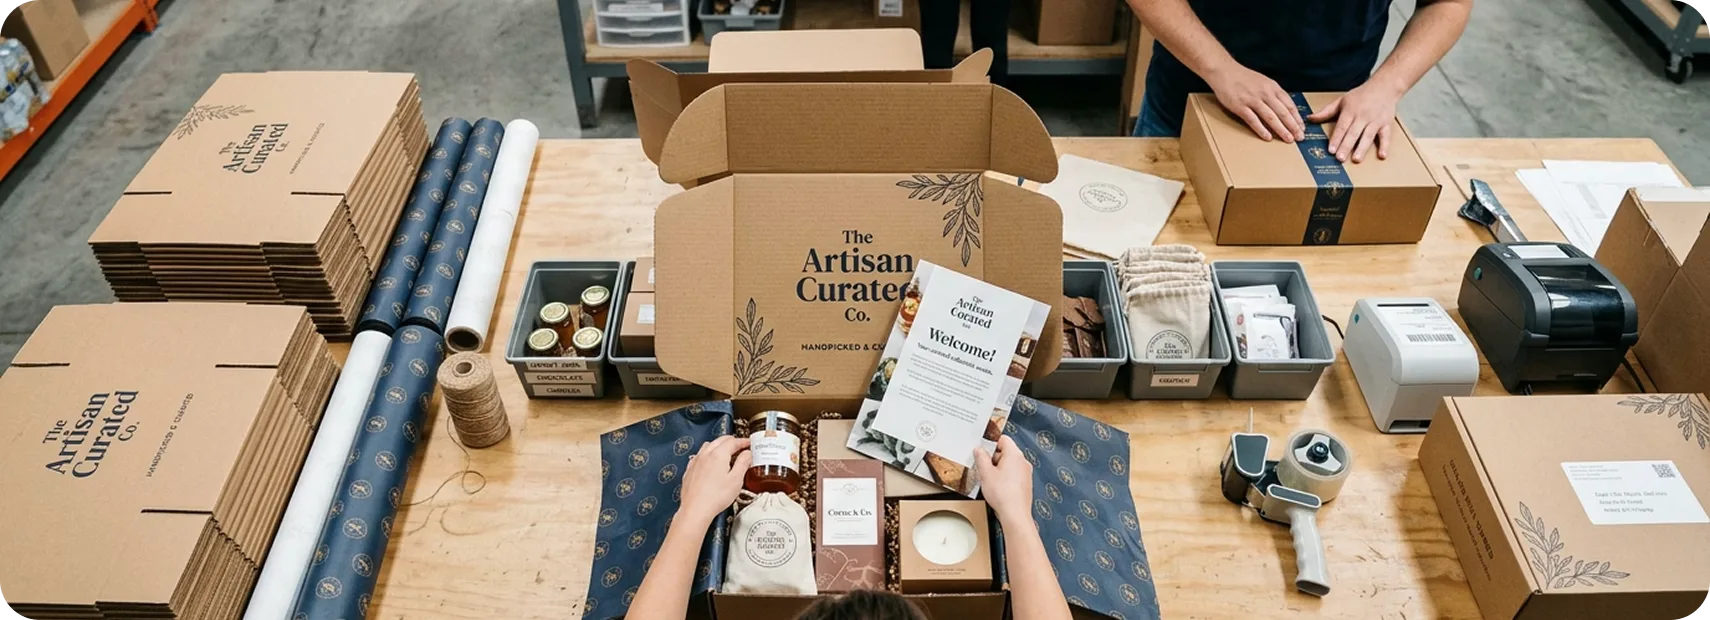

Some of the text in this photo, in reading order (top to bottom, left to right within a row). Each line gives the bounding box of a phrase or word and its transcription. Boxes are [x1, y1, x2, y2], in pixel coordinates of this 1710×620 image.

[222, 124, 267, 172] Artisan
[842, 230, 873, 243] The
[802, 247, 913, 273] Artisan
[844, 307, 871, 322] Co.
[929, 327, 997, 362] Welcome!
[42, 419, 67, 444] The
[45, 393, 110, 475] Artisan
[118, 421, 140, 442] Co.
